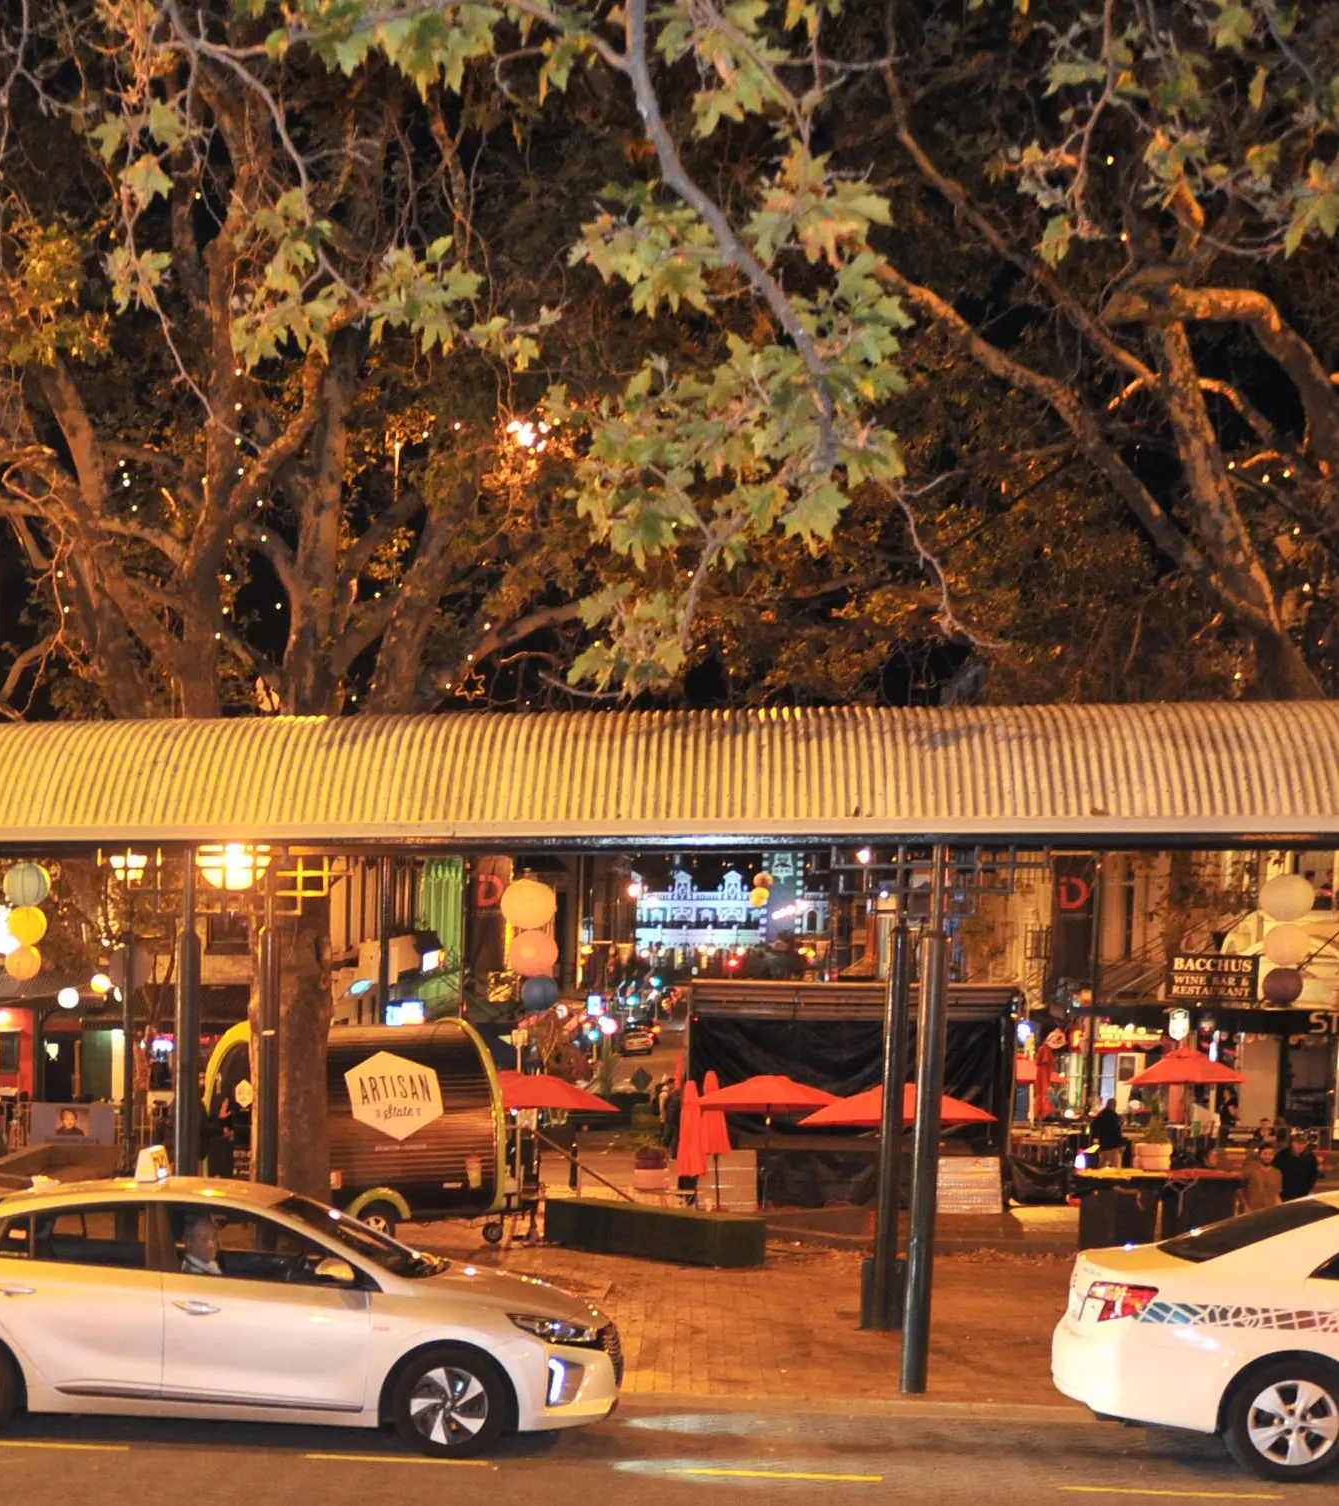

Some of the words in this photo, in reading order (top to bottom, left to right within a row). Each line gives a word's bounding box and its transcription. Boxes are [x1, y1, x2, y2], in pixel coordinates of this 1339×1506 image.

[1173, 957, 1253, 973] BACCHUS
[1173, 975, 1207, 986] WINE
[1213, 975, 1236, 987] BAR
[1241, 976, 1250, 987] &
[1172, 985, 1250, 997] RESTAURANT
[358, 1074, 432, 1106] ARTISAN
